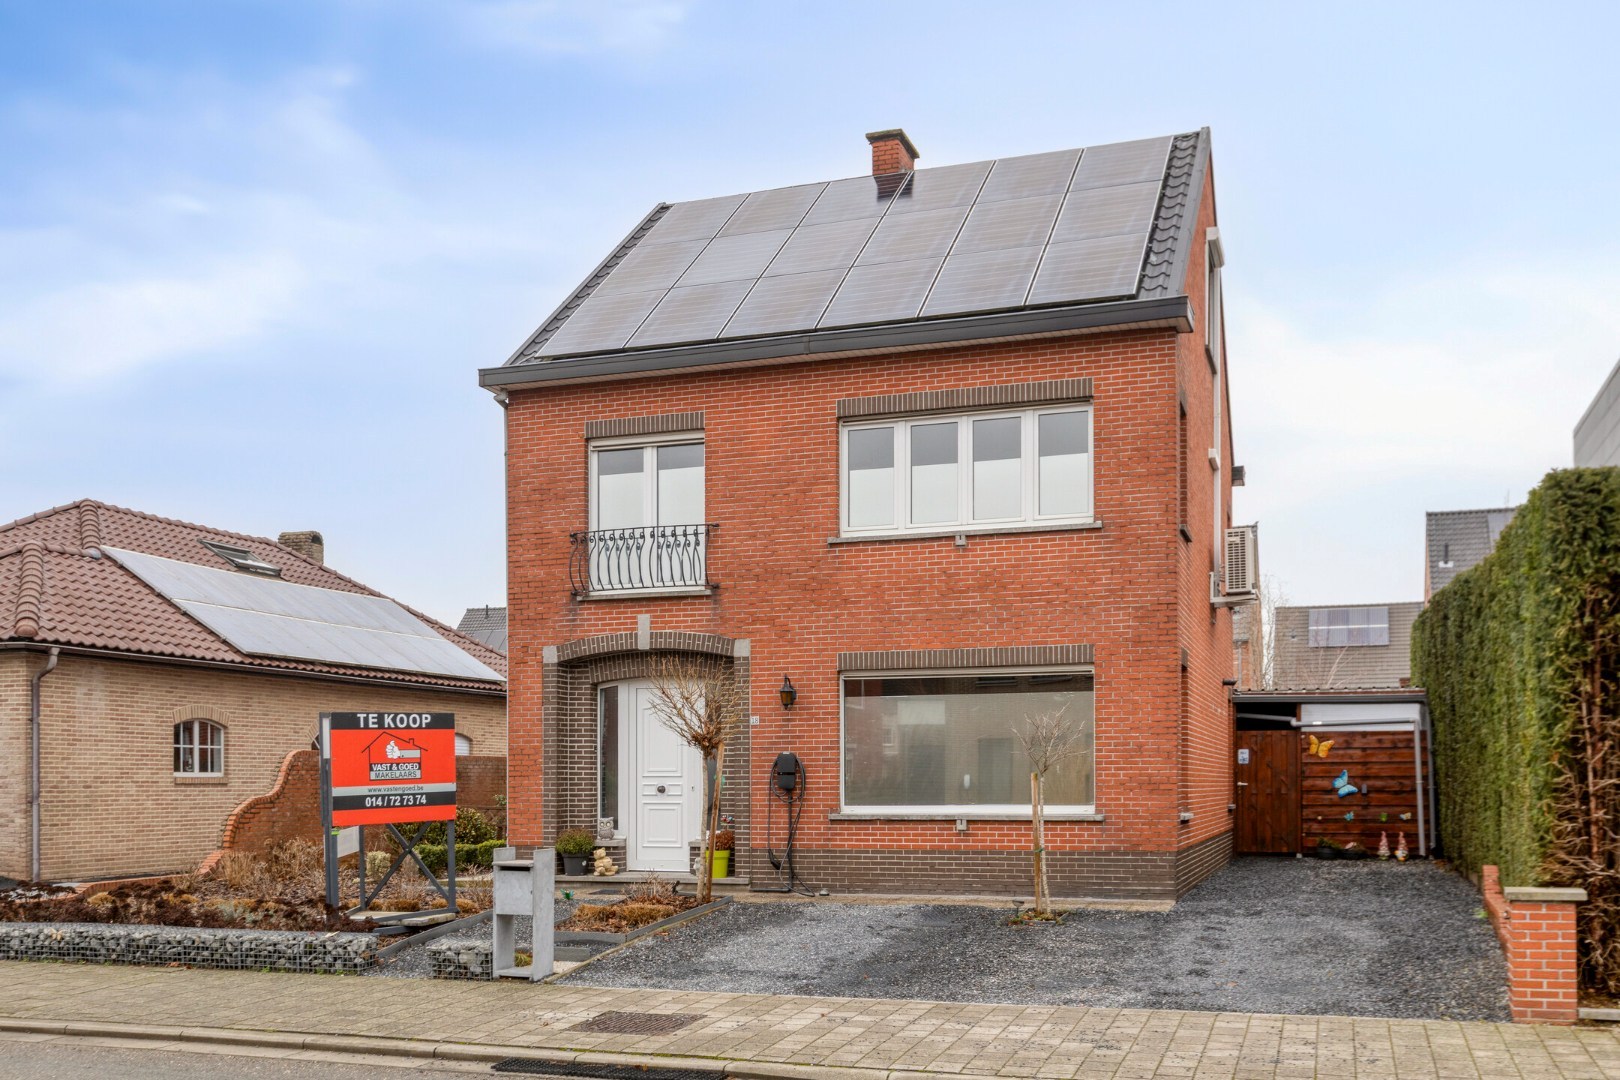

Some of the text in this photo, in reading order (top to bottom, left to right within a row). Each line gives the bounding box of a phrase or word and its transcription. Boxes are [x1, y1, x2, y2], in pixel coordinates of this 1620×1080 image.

[357, 714, 432, 728] TE KOOP
[365, 796, 382, 807] 014
[390, 796, 401, 806] 72
[403, 795, 414, 805] 73
[416, 794, 427, 805] 74
